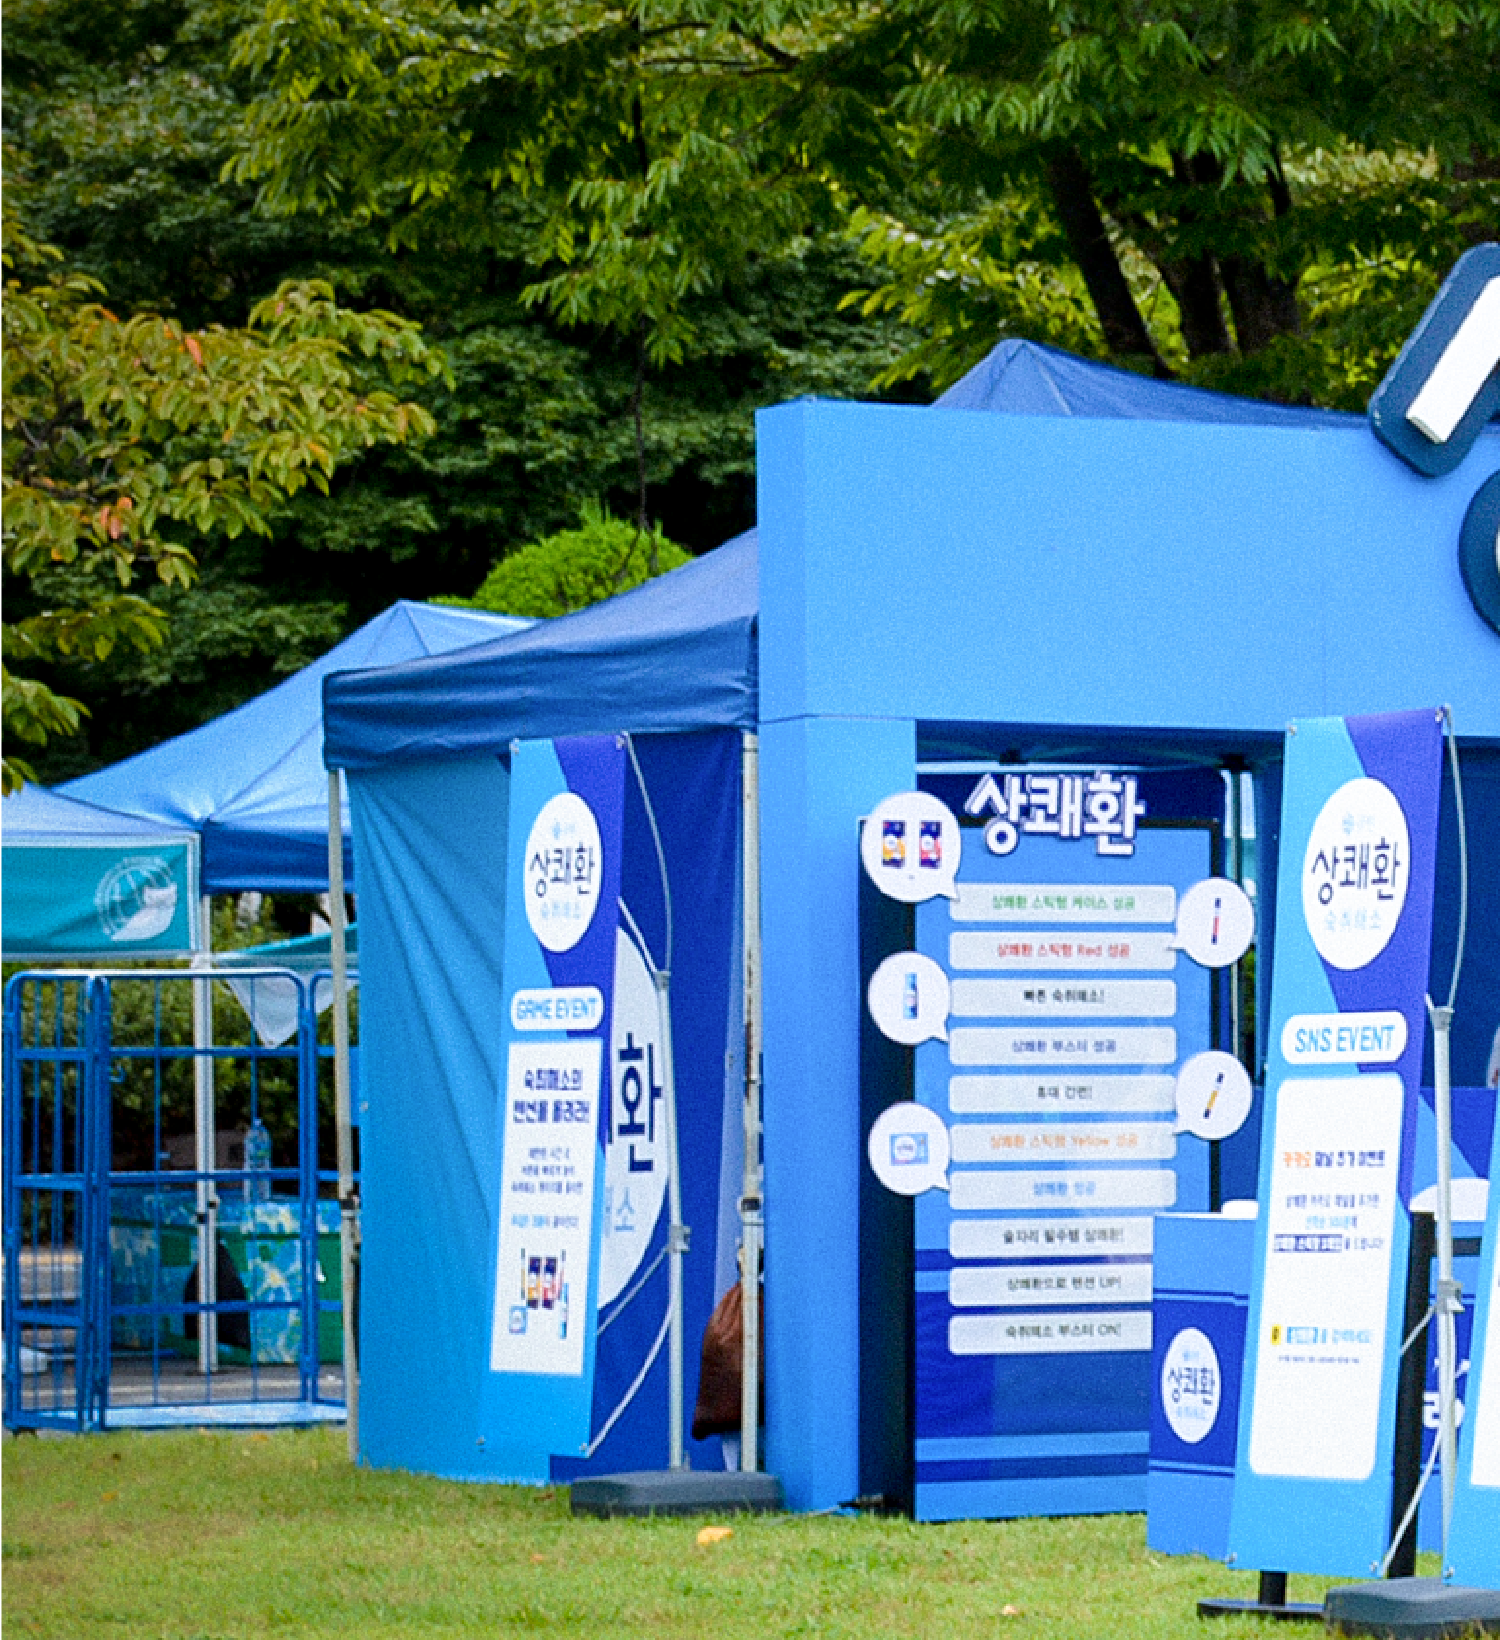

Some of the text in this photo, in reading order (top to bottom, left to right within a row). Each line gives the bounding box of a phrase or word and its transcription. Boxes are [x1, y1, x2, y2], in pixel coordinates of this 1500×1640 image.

[964, 770, 1145, 858] 상쾌환
[530, 842, 596, 898] 상쾌환
[1312, 836, 1400, 905] 상쾌환
[1295, 1025, 1395, 1053] SNS EVENT
